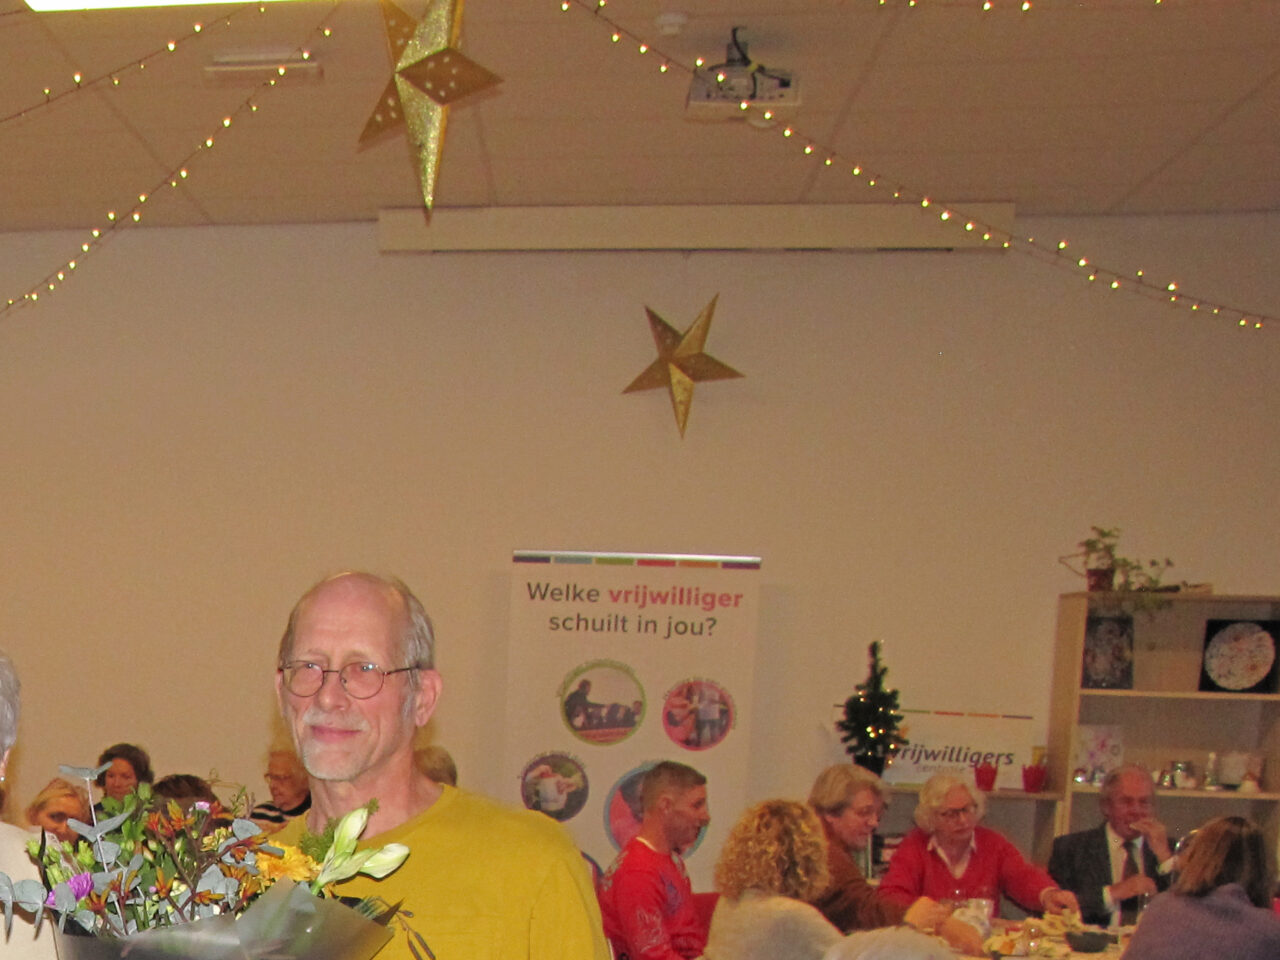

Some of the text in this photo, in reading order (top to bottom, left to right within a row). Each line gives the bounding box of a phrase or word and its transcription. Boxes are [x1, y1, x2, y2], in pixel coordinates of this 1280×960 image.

[526, 582, 744, 611] Welke vrijwilliger
[548, 613, 718, 639] schuilt in jou?
